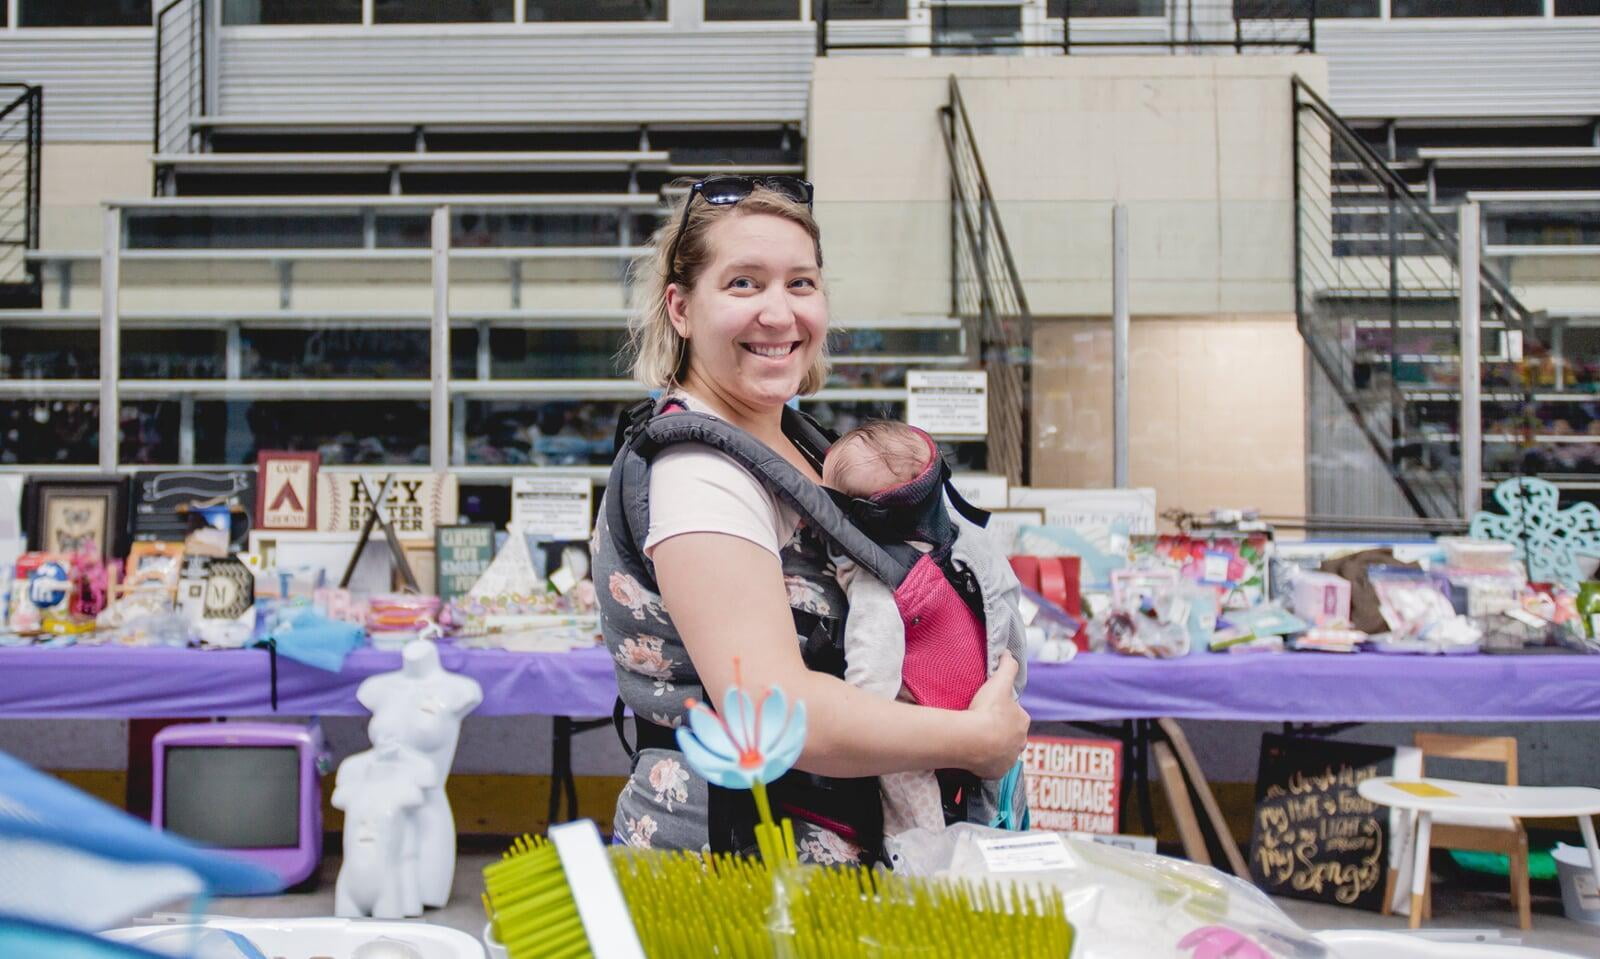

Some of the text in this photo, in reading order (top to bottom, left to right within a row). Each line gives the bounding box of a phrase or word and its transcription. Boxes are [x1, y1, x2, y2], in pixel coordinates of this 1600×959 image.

[350, 506, 422, 518] BATER
[1024, 743, 1115, 777] EFIGHTER
[1040, 778, 1115, 814] COURAGE
